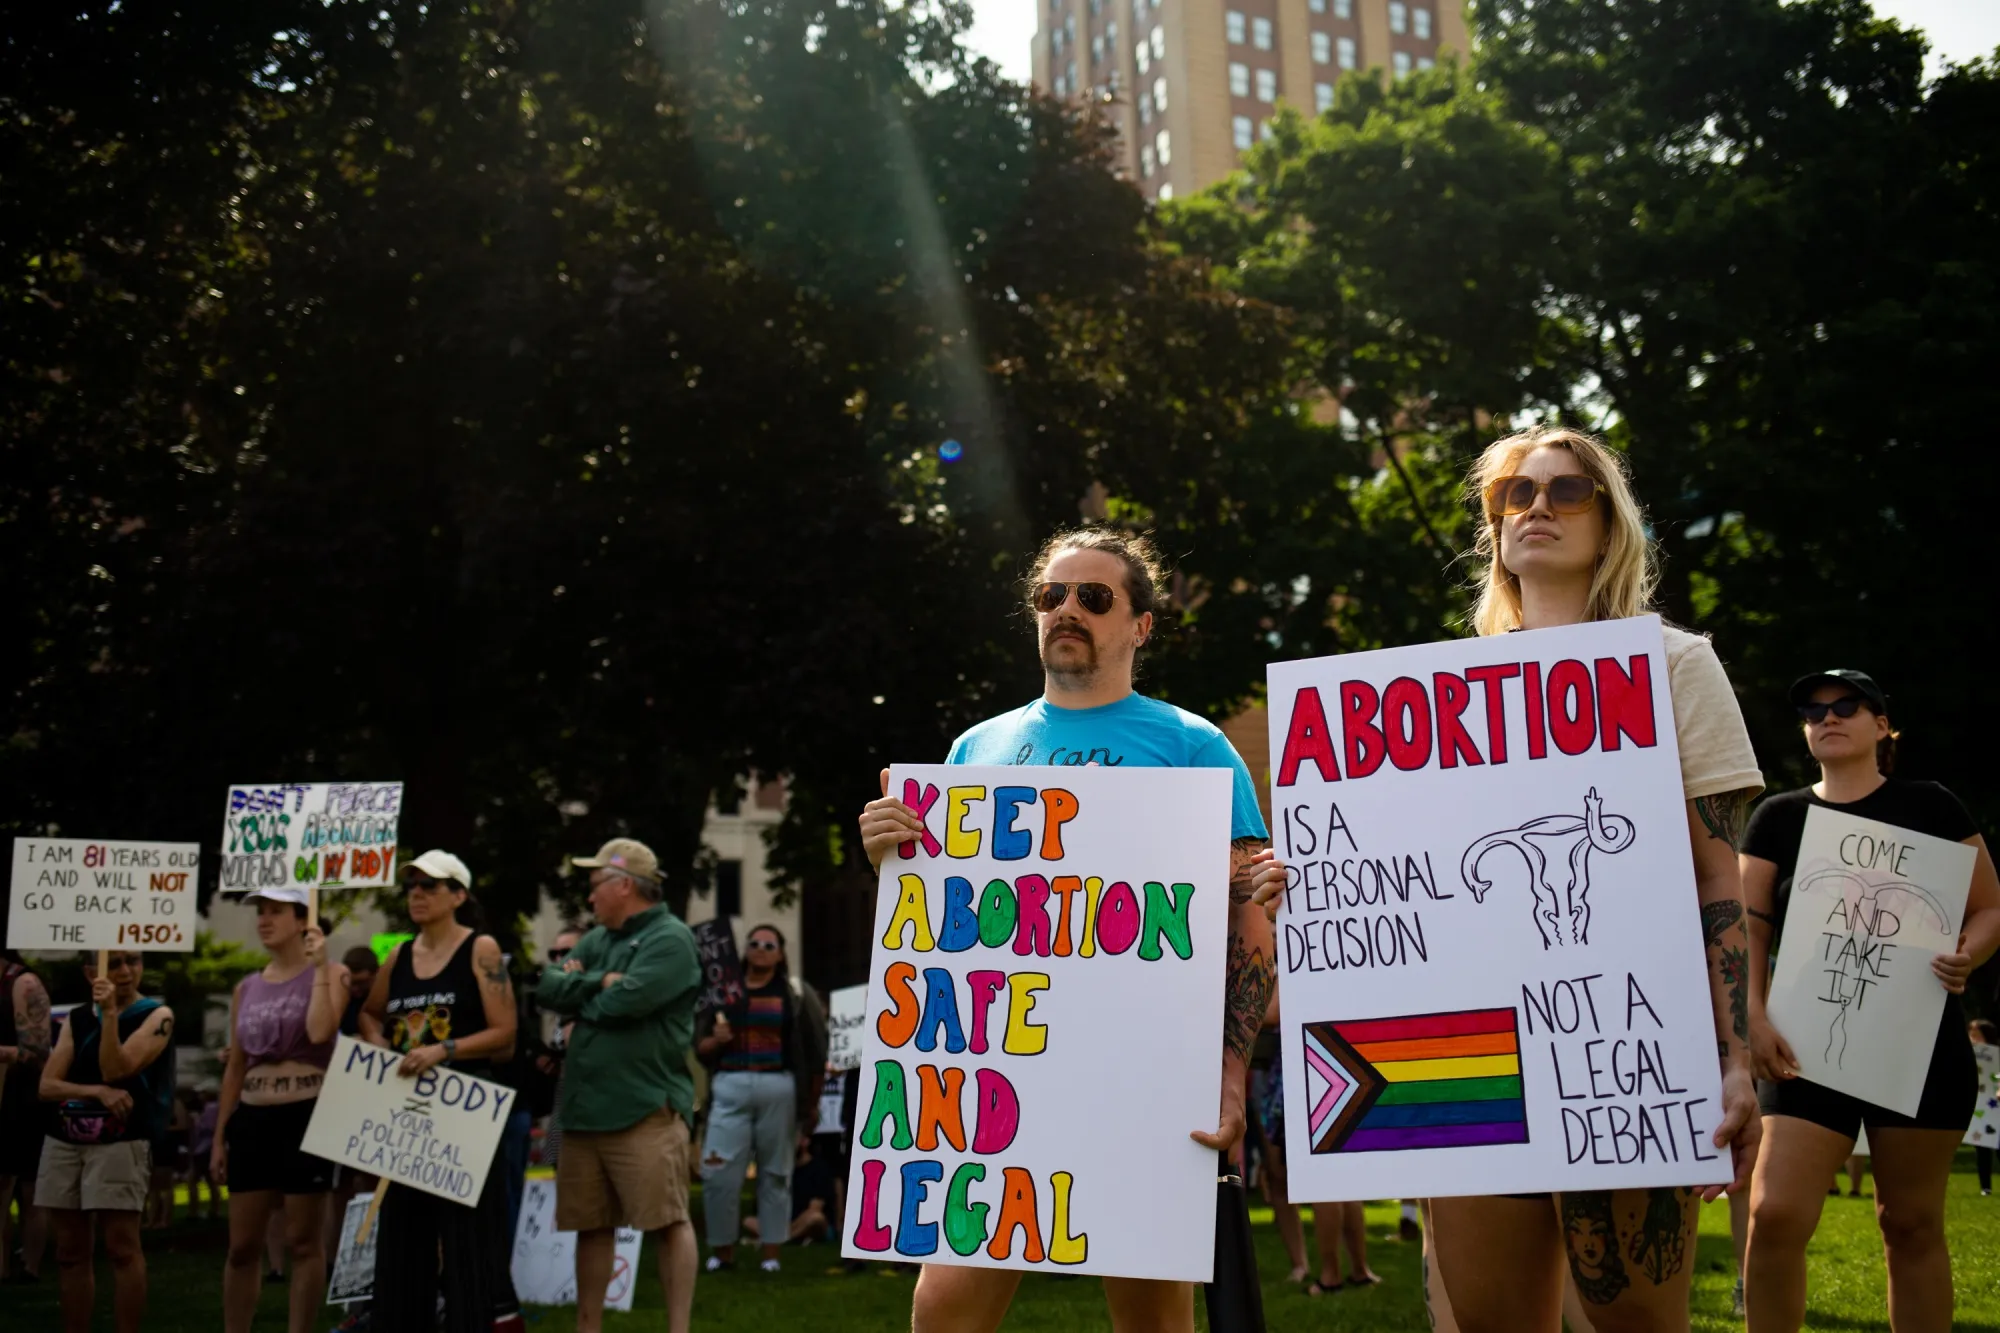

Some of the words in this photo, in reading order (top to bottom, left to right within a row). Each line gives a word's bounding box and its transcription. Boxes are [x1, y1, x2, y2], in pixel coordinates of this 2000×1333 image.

[1276, 653, 1657, 787] ABORTION
[1049, 747, 1124, 766] can
[230, 784, 312, 815] DON'T
[325, 783, 401, 815] FORCE
[898, 778, 1080, 861] KEEP
[228, 814, 290, 853] YOUR
[1284, 804, 1317, 858] IS
[1326, 802, 1358, 855] A
[1839, 834, 1916, 878] COME
[27, 845, 35, 862] I
[43, 847, 72, 863] AM
[83, 845, 105, 868] 81
[111, 848, 160, 867] YEARS
[168, 852, 199, 868] OLD
[37, 870, 79, 888] AND
[94, 872, 137, 890] WILL
[149, 873, 189, 892] NOT
[221, 853, 287, 887] VIEWS
[294, 852, 318, 883] ON
[324, 851, 346, 882] MY
[351, 846, 395, 883] BODY
[23, 893, 54, 911] GO
[75, 894, 132, 914] BACK
[151, 897, 175, 915] TO
[1283, 851, 1454, 915] PERSONAL
[49, 924, 85, 942] THE
[117, 923, 182, 944] 1950's
[882, 873, 1195, 961] ABORTION
[1285, 912, 1428, 974] DECISION
[1826, 898, 1901, 938] AND
[1822, 932, 1897, 978] TAKE
[876, 961, 1051, 1056] SAFE
[1522, 974, 1603, 1036] NOT
[1627, 972, 1664, 1031] A
[1817, 969, 1878, 1011] IT
[345, 1043, 398, 1084] MY
[413, 1067, 510, 1122] BODY
[1550, 1039, 1688, 1100] LEGAL
[389, 1108, 435, 1136] YOUR
[859, 1059, 1020, 1155] AND
[1561, 1098, 1719, 1165] DEBATE
[345, 1135, 474, 1199] PLAYGROUND
[360, 1118, 463, 1167] POLITICAL
[853, 1159, 1088, 1265] LEGAL
